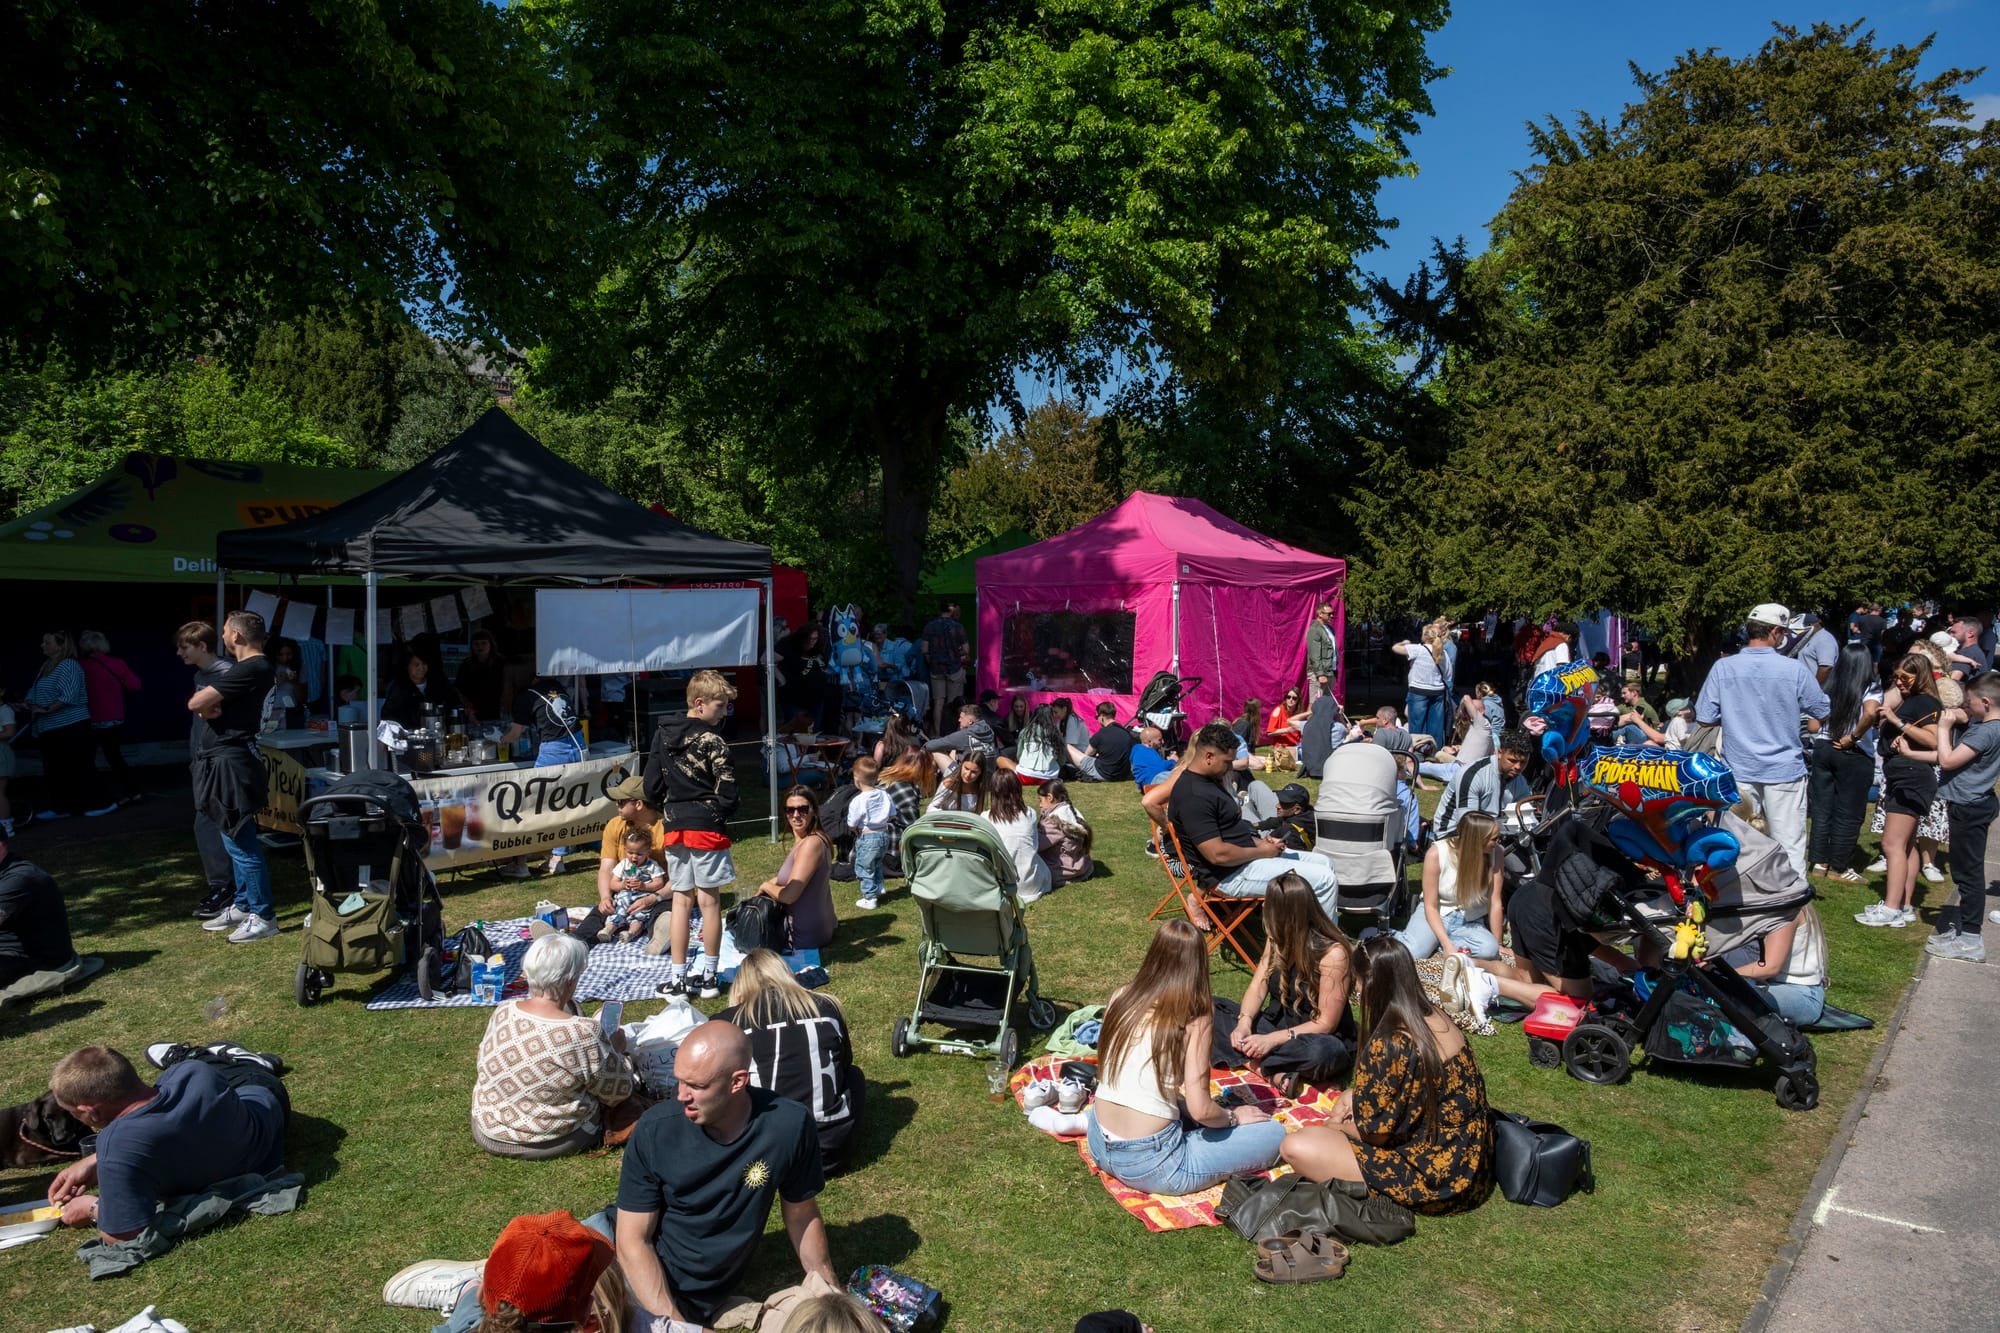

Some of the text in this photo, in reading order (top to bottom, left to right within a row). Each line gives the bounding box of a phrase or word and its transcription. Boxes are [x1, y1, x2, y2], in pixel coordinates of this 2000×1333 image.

[1592, 760, 1681, 793] SPIDER-MAN
[492, 820, 609, 851] Bubble Tea @ Lichfie
